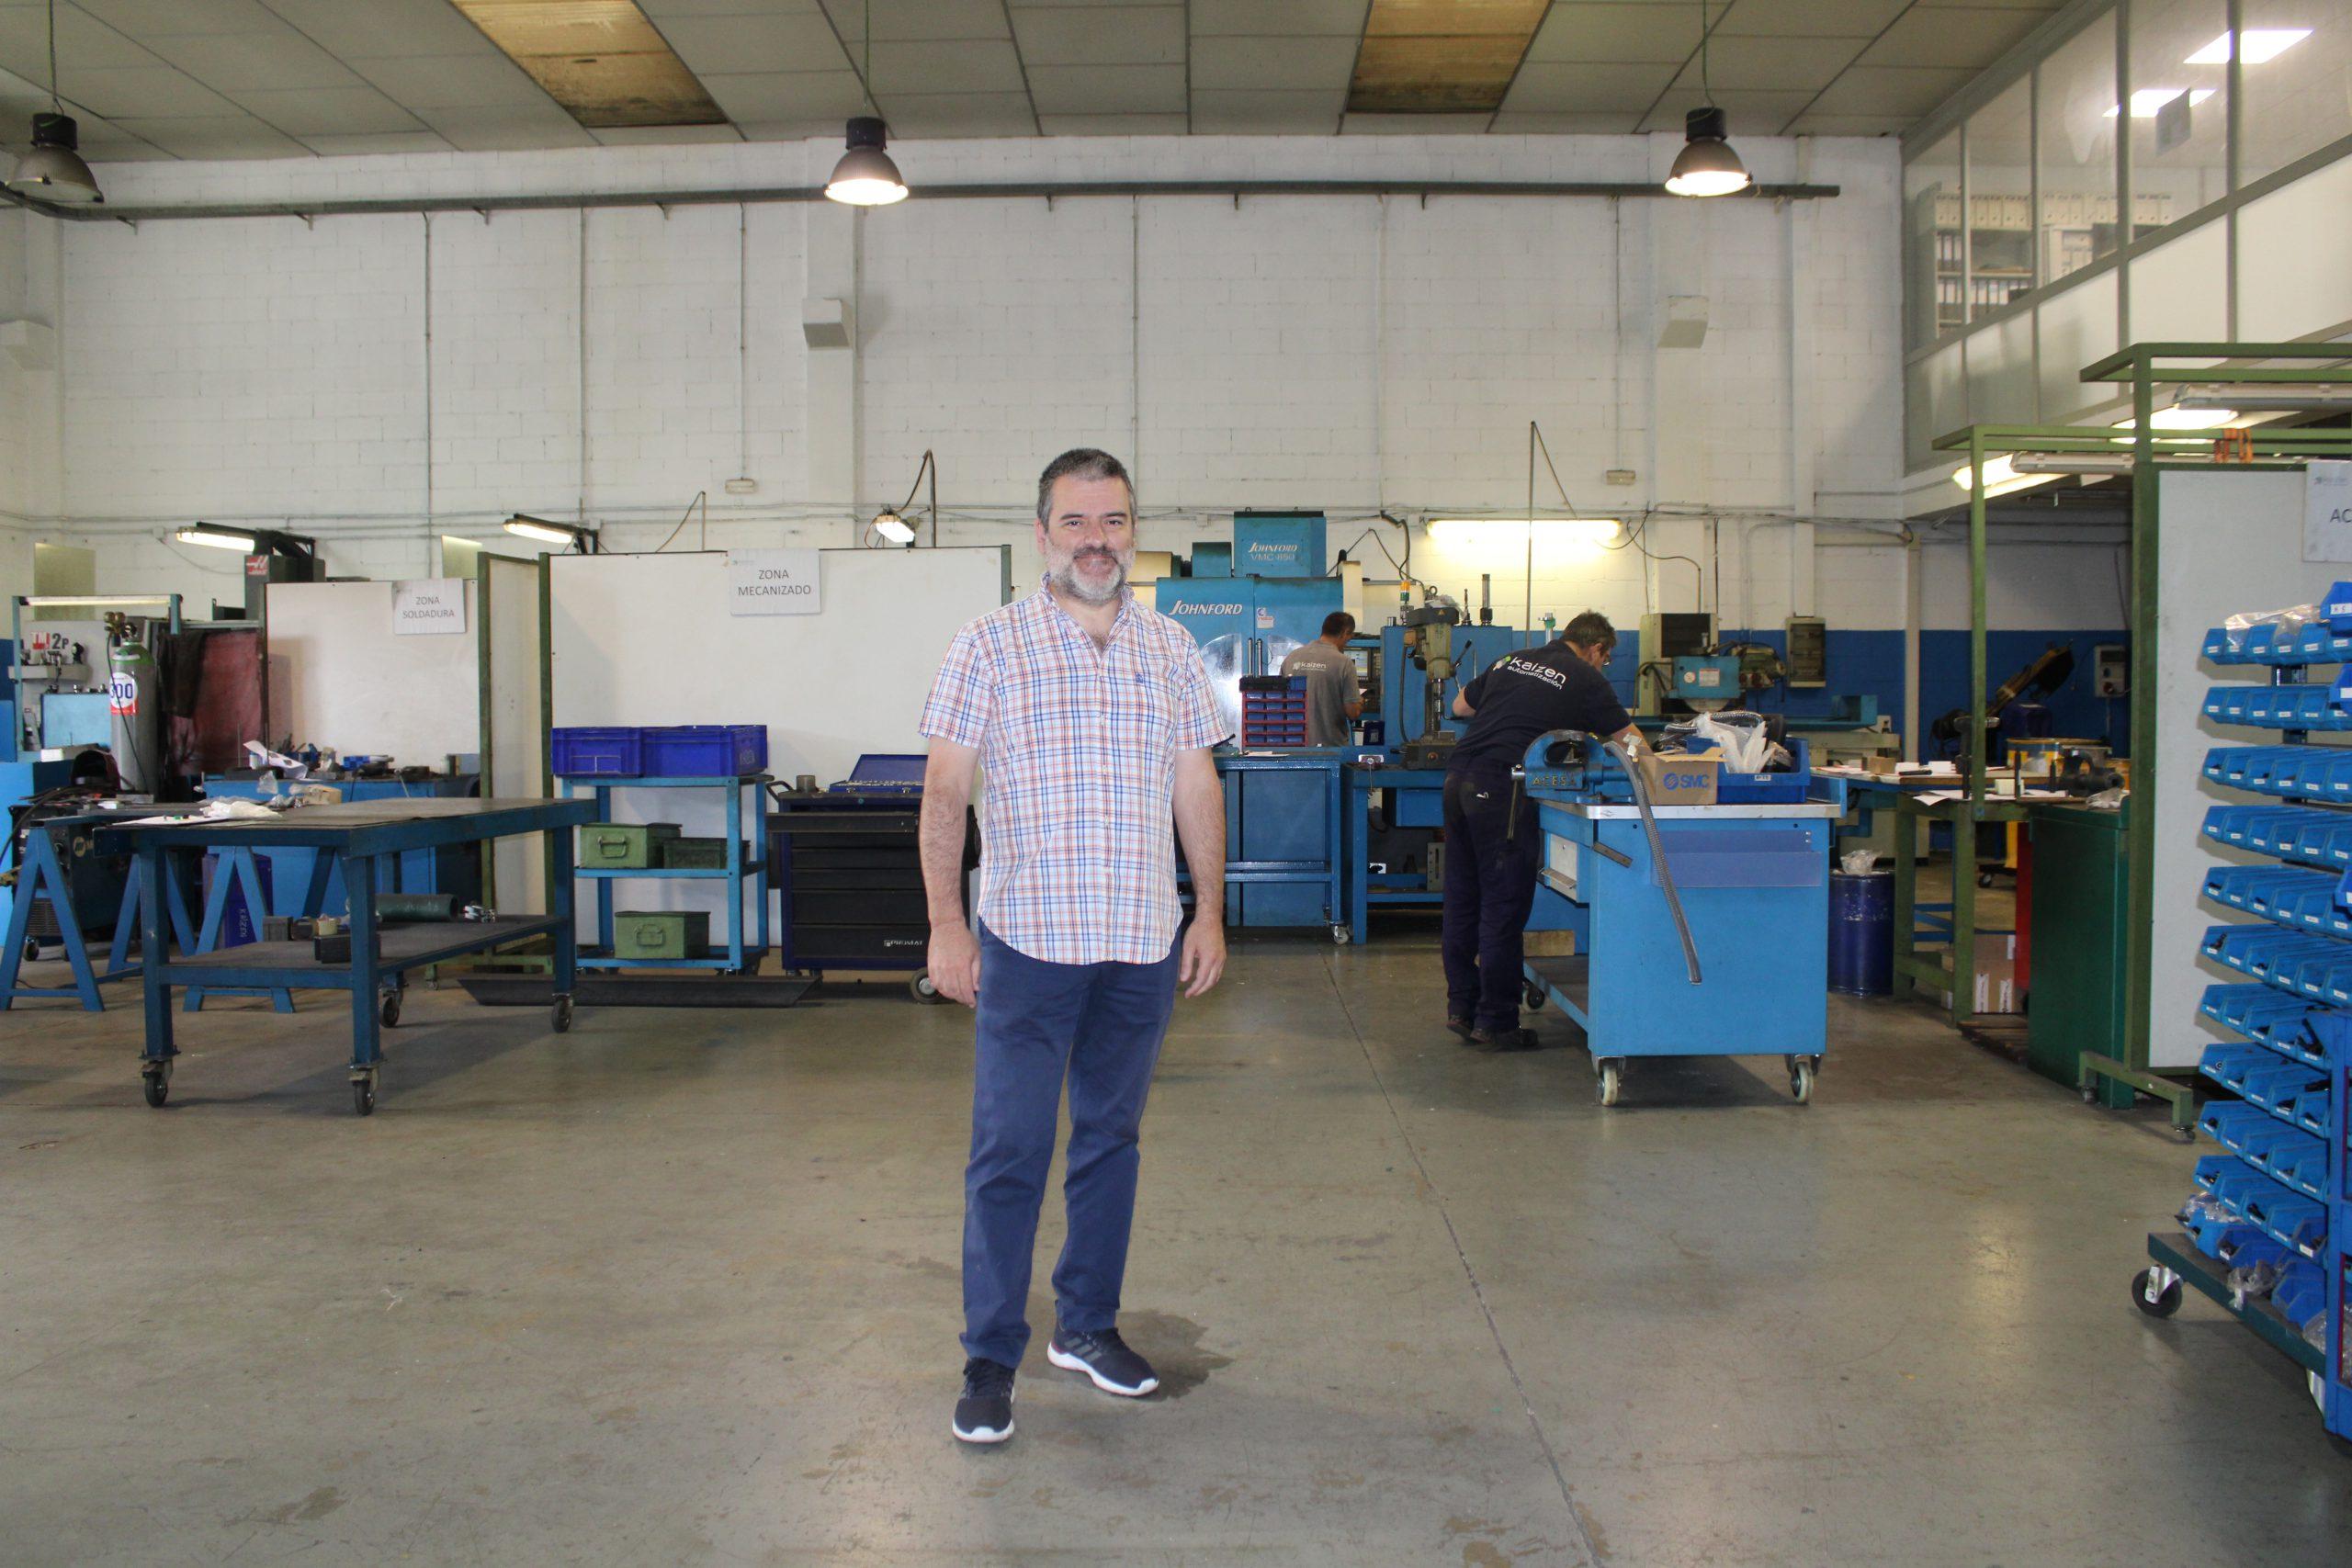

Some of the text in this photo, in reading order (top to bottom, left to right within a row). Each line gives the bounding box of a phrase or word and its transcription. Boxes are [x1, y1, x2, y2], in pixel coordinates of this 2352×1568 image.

[759, 570, 789, 580] ZONA
[738, 585, 811, 595] MECANIZADO
[415, 596, 440, 605] ZONA
[1169, 600, 1243, 615] JOHNFORD
[402, 610, 456, 618] SOLDADURA
[1510, 656, 1566, 684] kaizen
[1507, 665, 1563, 691] automatización
[1680, 774, 1709, 788] SMC
